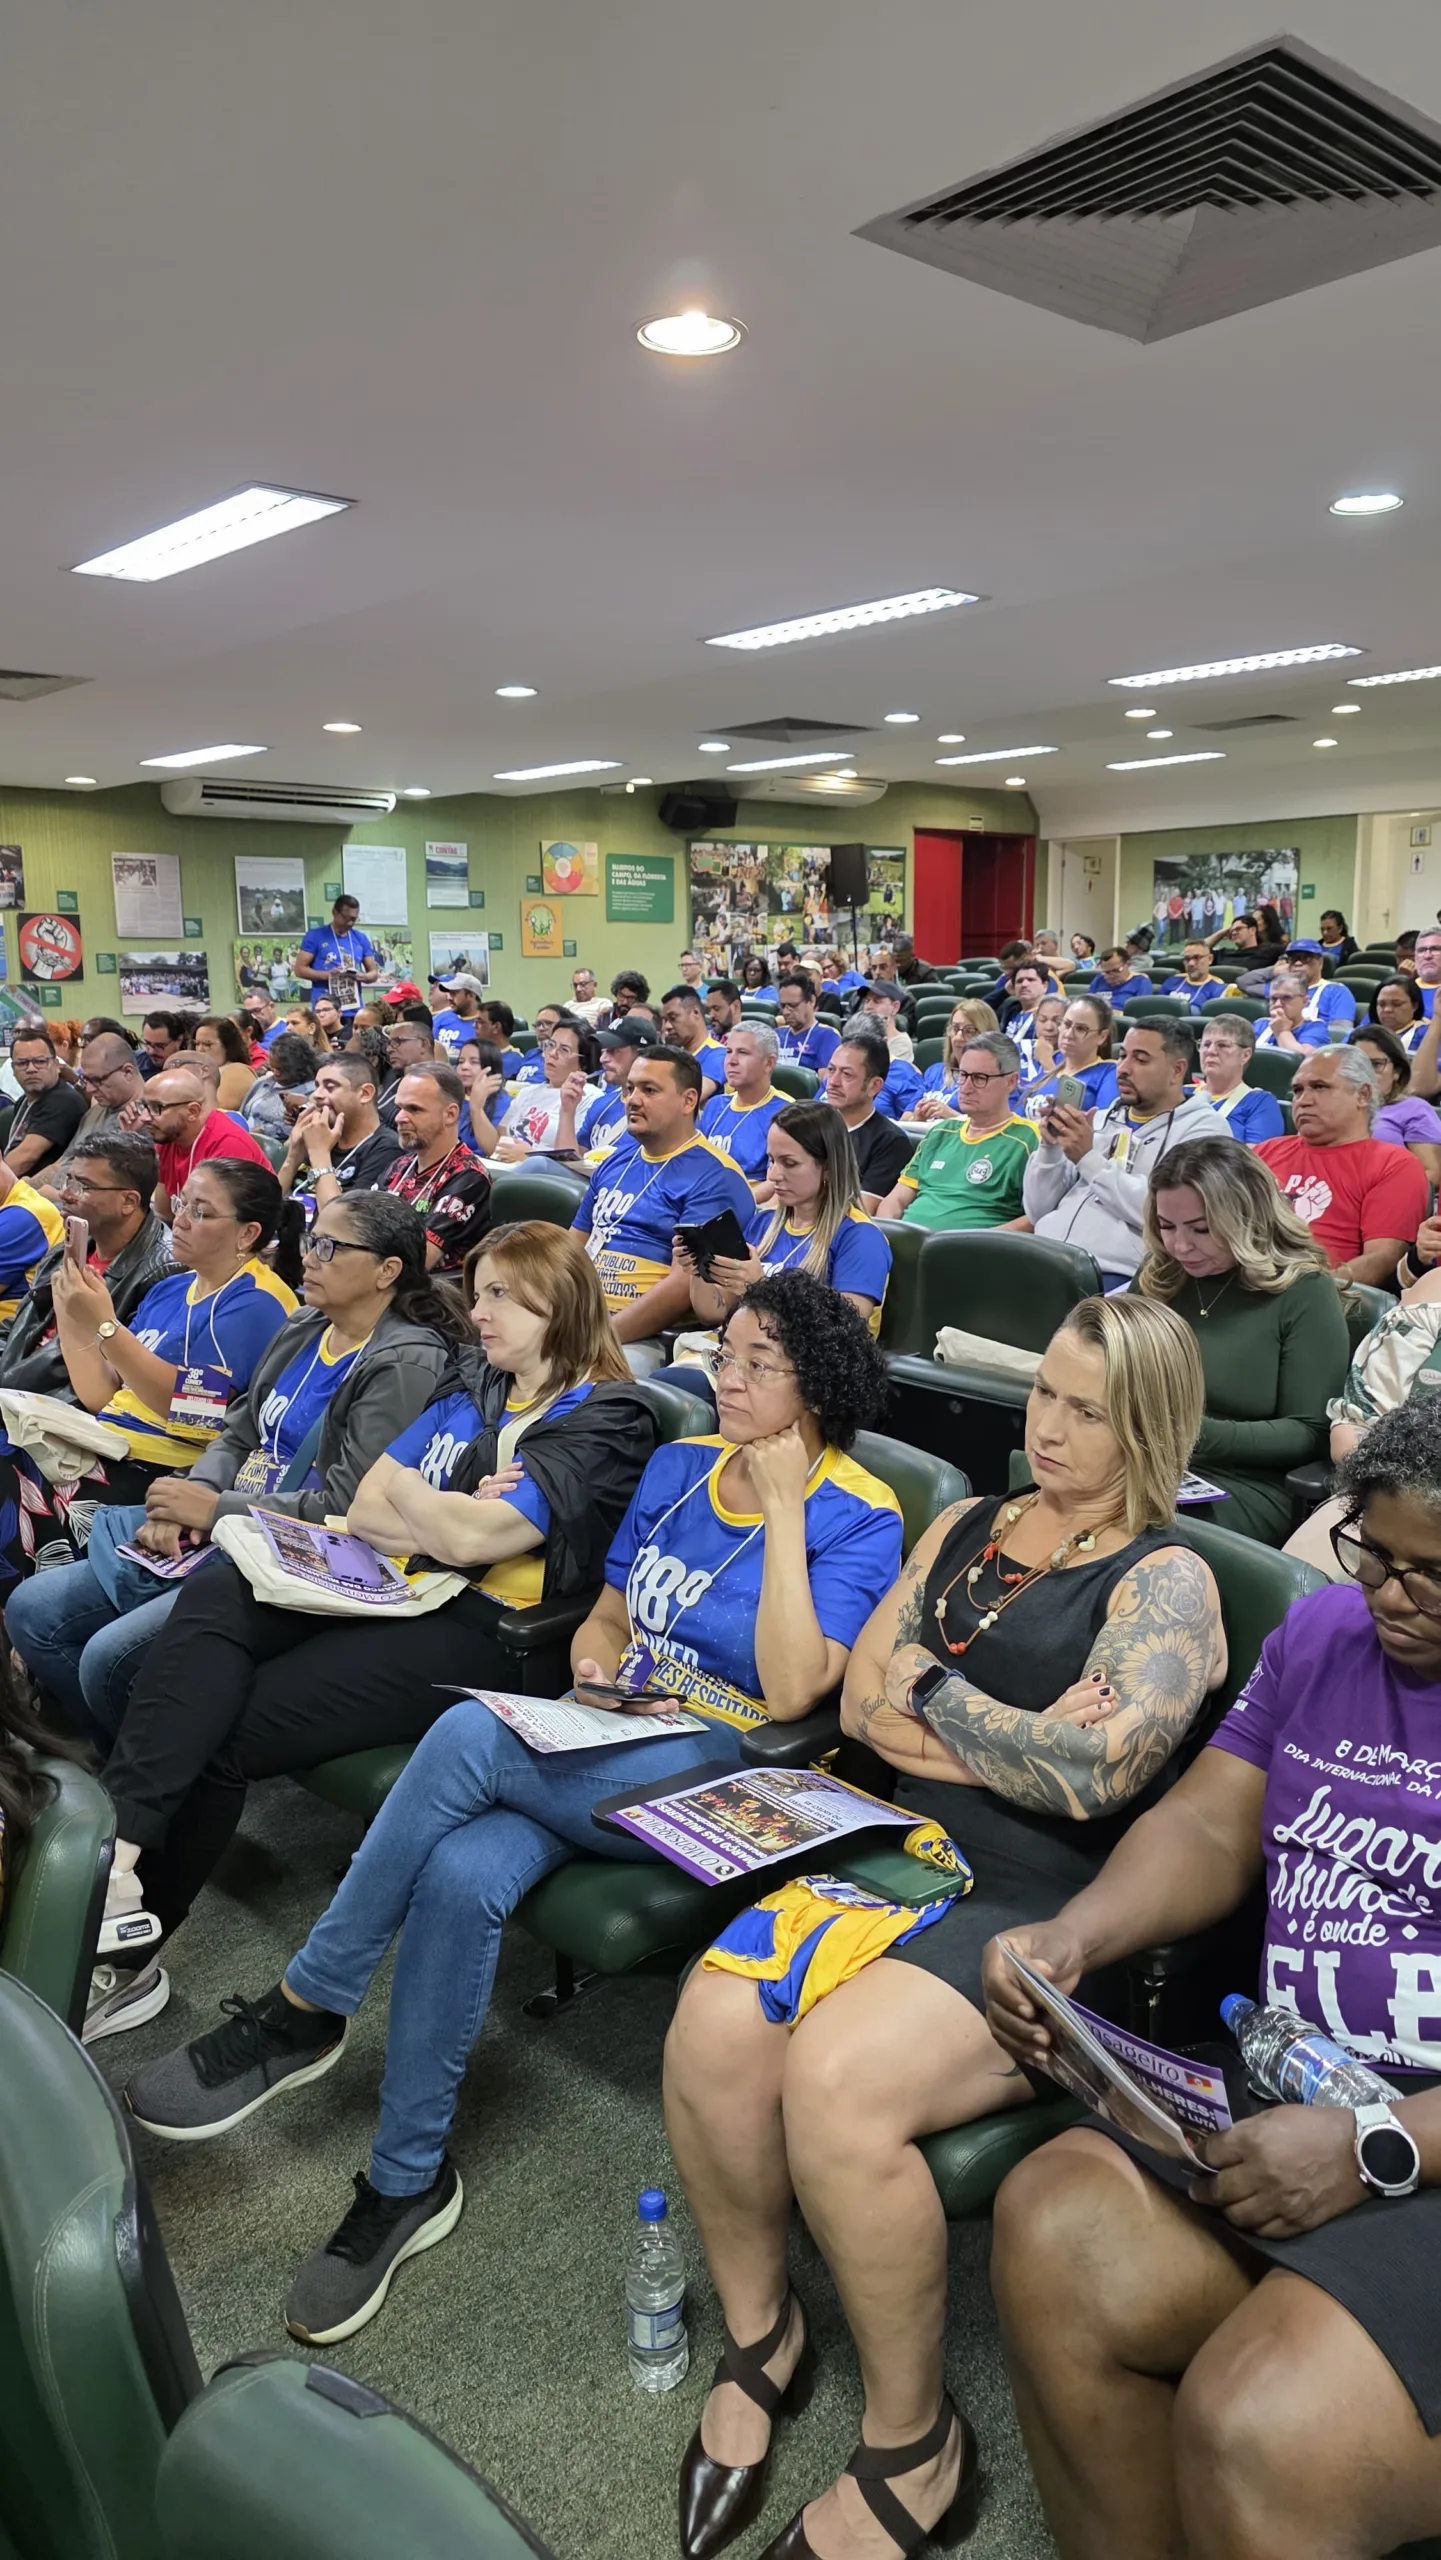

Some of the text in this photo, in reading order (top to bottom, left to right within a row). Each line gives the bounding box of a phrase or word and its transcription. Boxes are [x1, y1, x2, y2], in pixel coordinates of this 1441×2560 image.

[188, 1368, 204, 1380] 38º
[1283, 1743, 1432, 1797] DIA INTERNACIONAL DA
[1335, 1740, 1353, 1758] 8
[1378, 1744, 1441, 1782] MARÇ
[639, 1815, 719, 1870] O Mensageiro
[699, 1830, 724, 1843] DAS
[718, 1841, 756, 1862] MARÇO
[1303, 1910, 1390, 1947] é onde
[1089, 2025, 1180, 2081] nsageiro
[1188, 2112, 1216, 2130] LUTA
